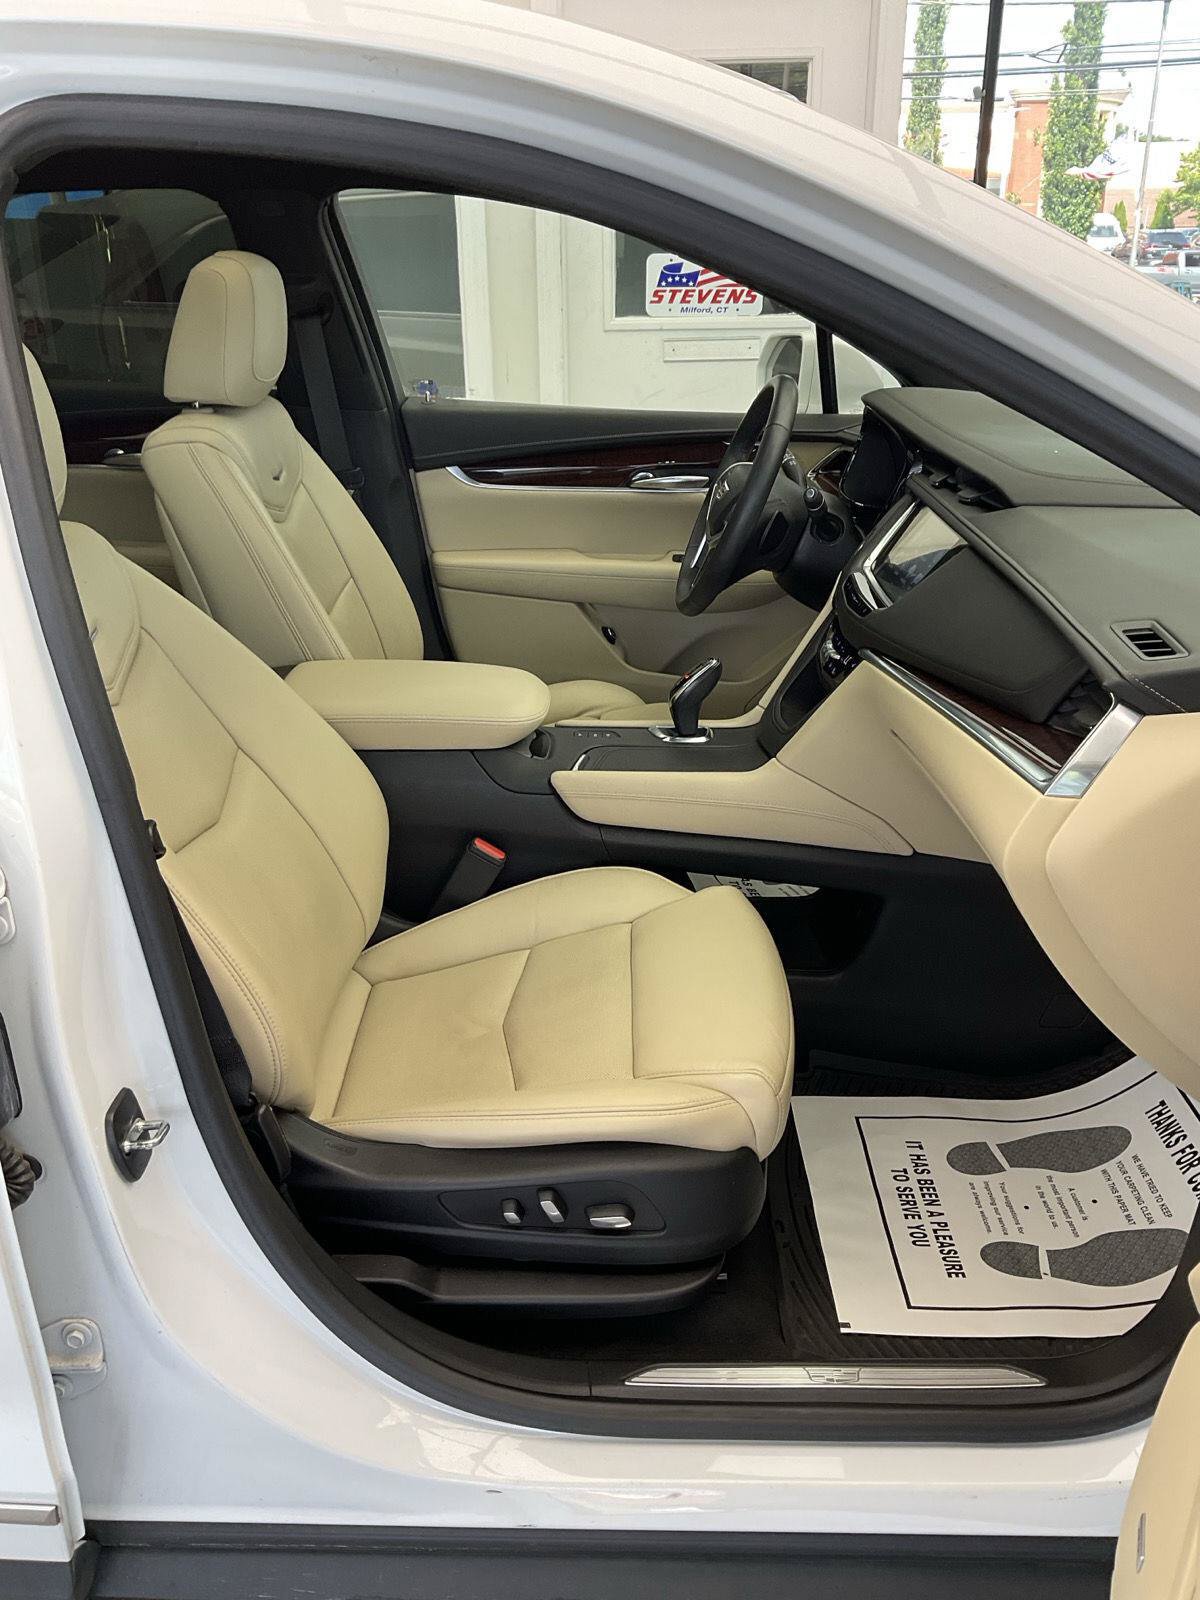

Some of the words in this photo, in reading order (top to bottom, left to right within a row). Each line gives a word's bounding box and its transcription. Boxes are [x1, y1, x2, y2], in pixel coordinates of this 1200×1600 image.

[649, 288, 758, 304] STEVENS
[680, 306, 713, 314] Milford,
[905, 1141, 924, 1150] IT
[1145, 1099, 1188, 1148] THANKS
[1171, 1144, 1200, 1175] FOR
[891, 1168, 910, 1182] TO
[909, 1154, 931, 1175] HAS
[917, 1179, 942, 1207] BEEN
[1101, 1169, 1112, 1182] WITH
[1108, 1181, 1119, 1194] THIS
[1114, 1194, 1129, 1214] PAPER
[1124, 1214, 1136, 1225] MAT
[1116, 1161, 1128, 1176] YOUR
[1124, 1176, 1142, 1205] CARPETING
[1141, 1205, 1155, 1225] CLEAN
[1132, 1154, 1141, 1164] WE
[1137, 1164, 1149, 1178] HAVE
[1146, 1178, 1159, 1195] TRIED
[1154, 1194, 1163, 1202] TO
[1159, 1202, 1173, 1218] KEEP
[896, 1187, 922, 1220] SERVE
[907, 1224, 931, 1247] YOU
[930, 1221, 966, 1279] PLEASURE
